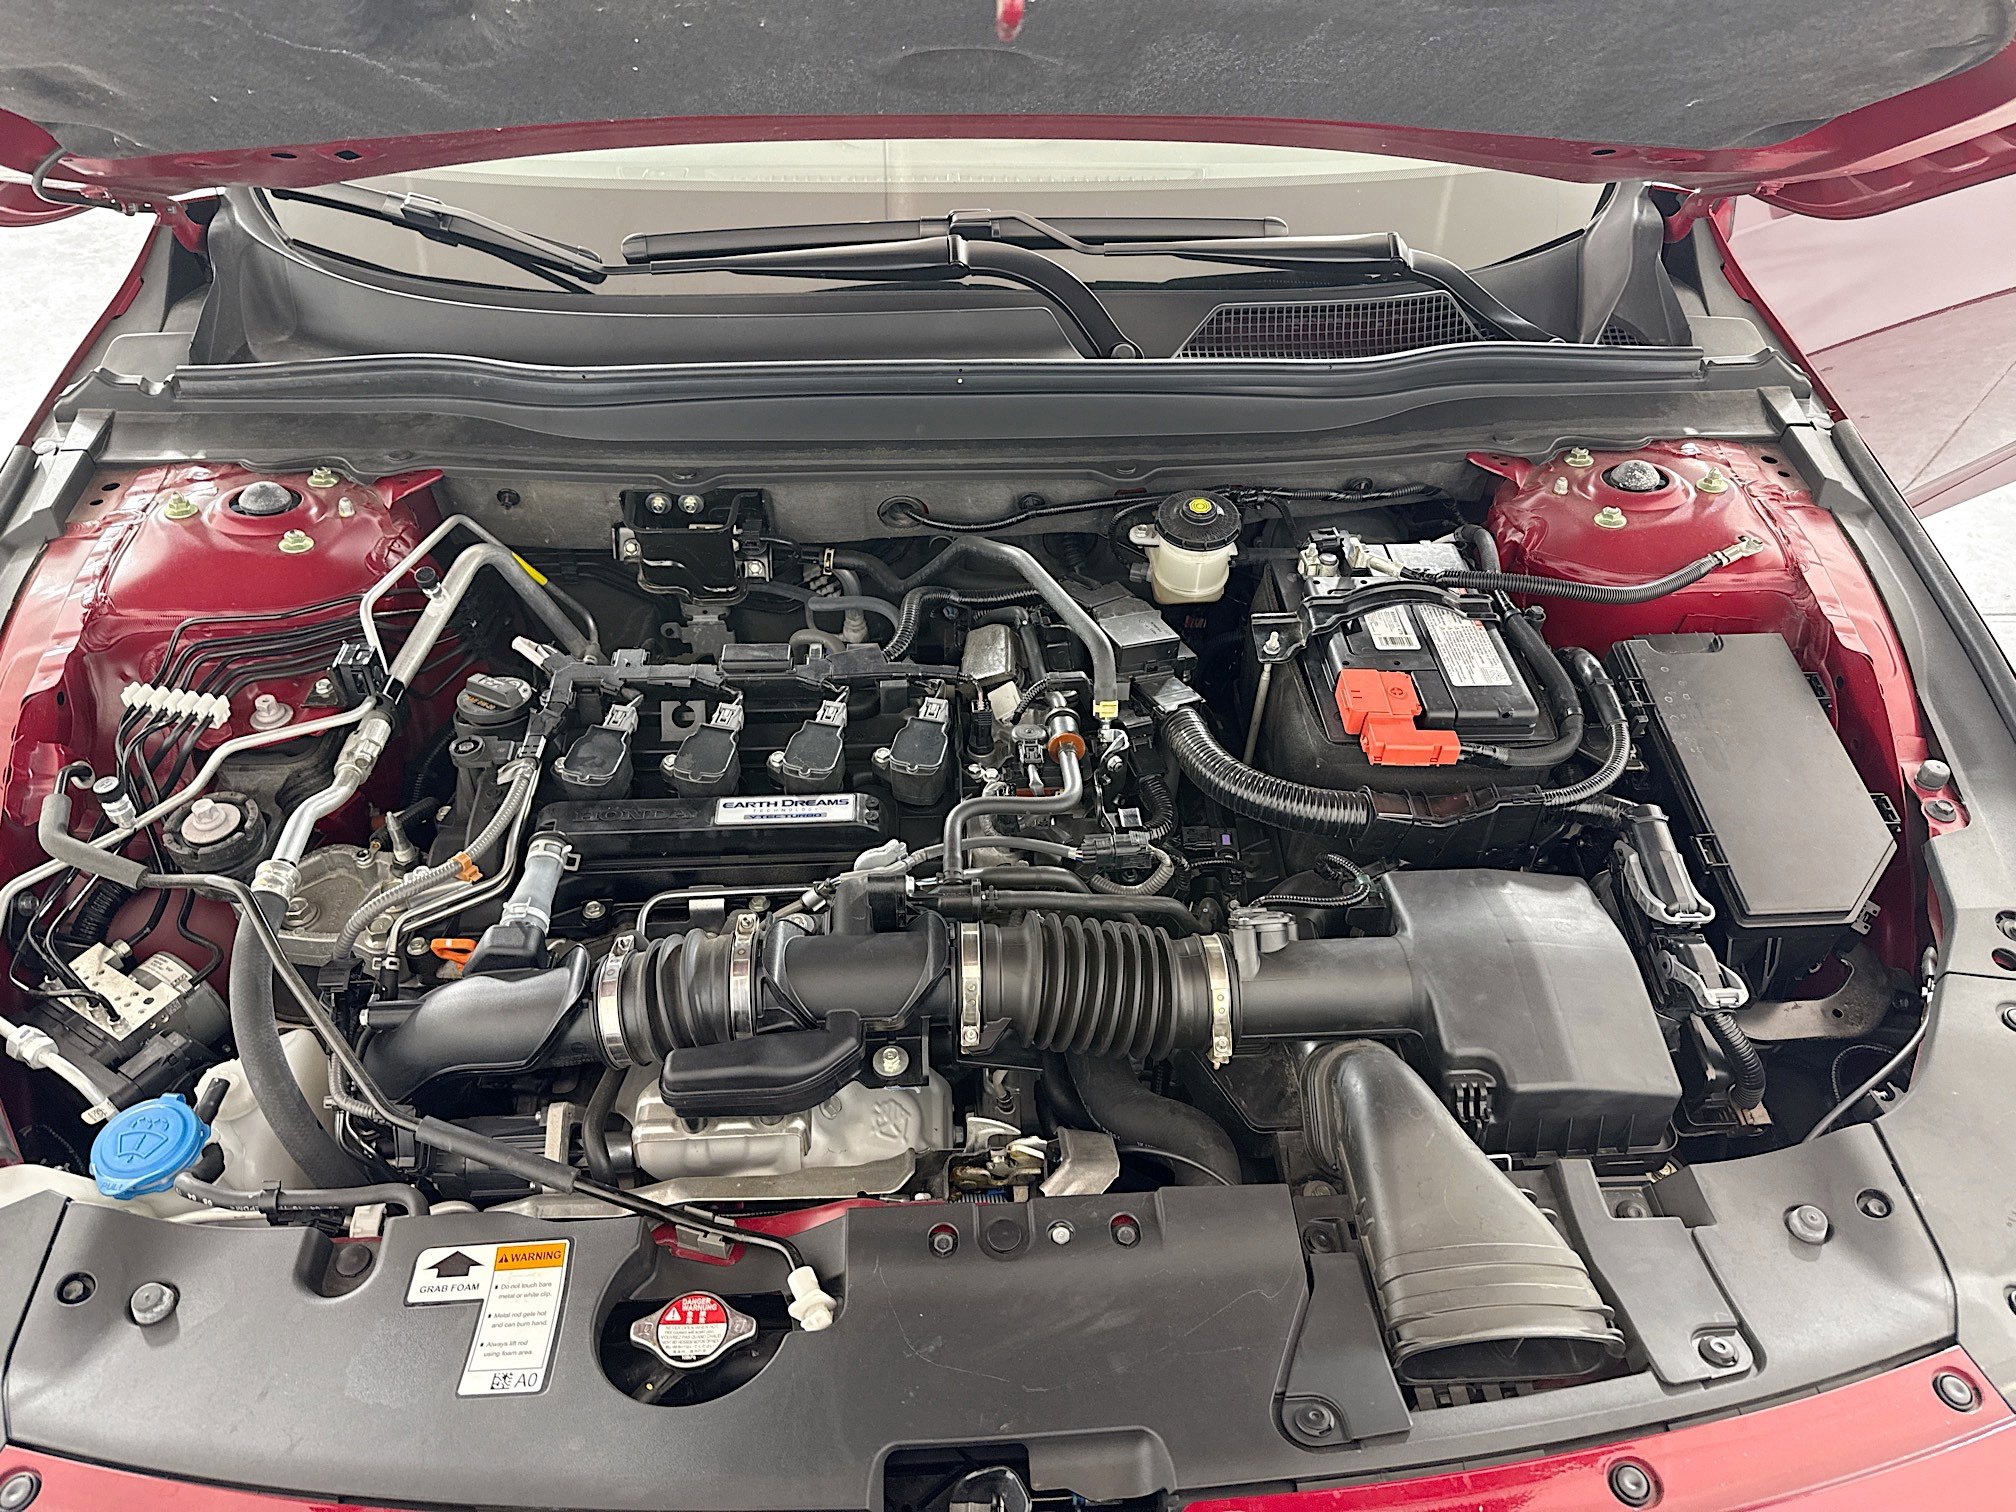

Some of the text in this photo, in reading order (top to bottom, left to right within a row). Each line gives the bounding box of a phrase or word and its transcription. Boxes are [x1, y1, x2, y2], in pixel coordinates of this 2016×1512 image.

[722, 799, 850, 809] EARTH DREAMS
[573, 807, 698, 822] HONDA
[511, 1250, 562, 1263] WARNING
[419, 1283, 480, 1294] GRAB FOAM
[682, 1297, 711, 1305] DANGER
[681, 1303, 717, 1312] WARNUNG
[523, 1311, 536, 1319] gets
[514, 1372, 538, 1388] A0
